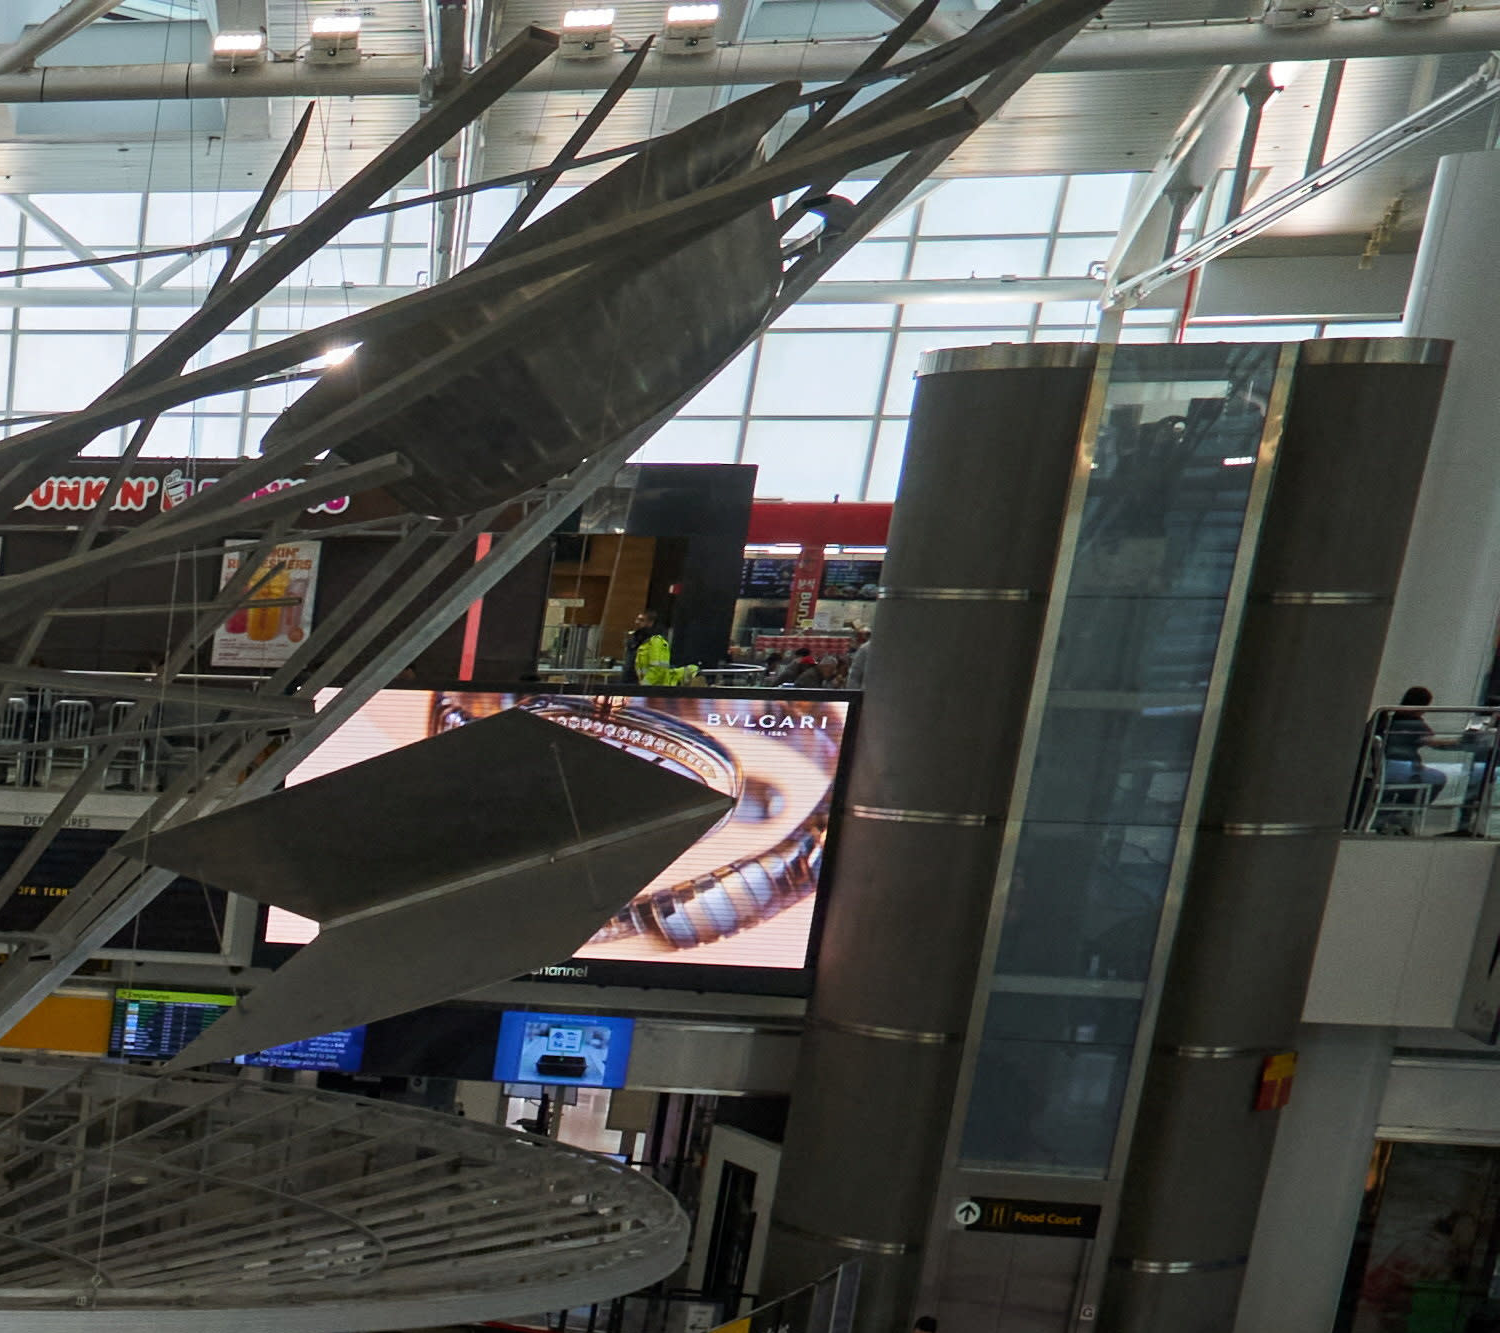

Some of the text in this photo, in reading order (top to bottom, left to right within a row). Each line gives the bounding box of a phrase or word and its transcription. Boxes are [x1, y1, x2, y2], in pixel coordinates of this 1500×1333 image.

[706, 713, 829, 730] BVLGARI
[1013, 1210, 1083, 1226] Food Court
